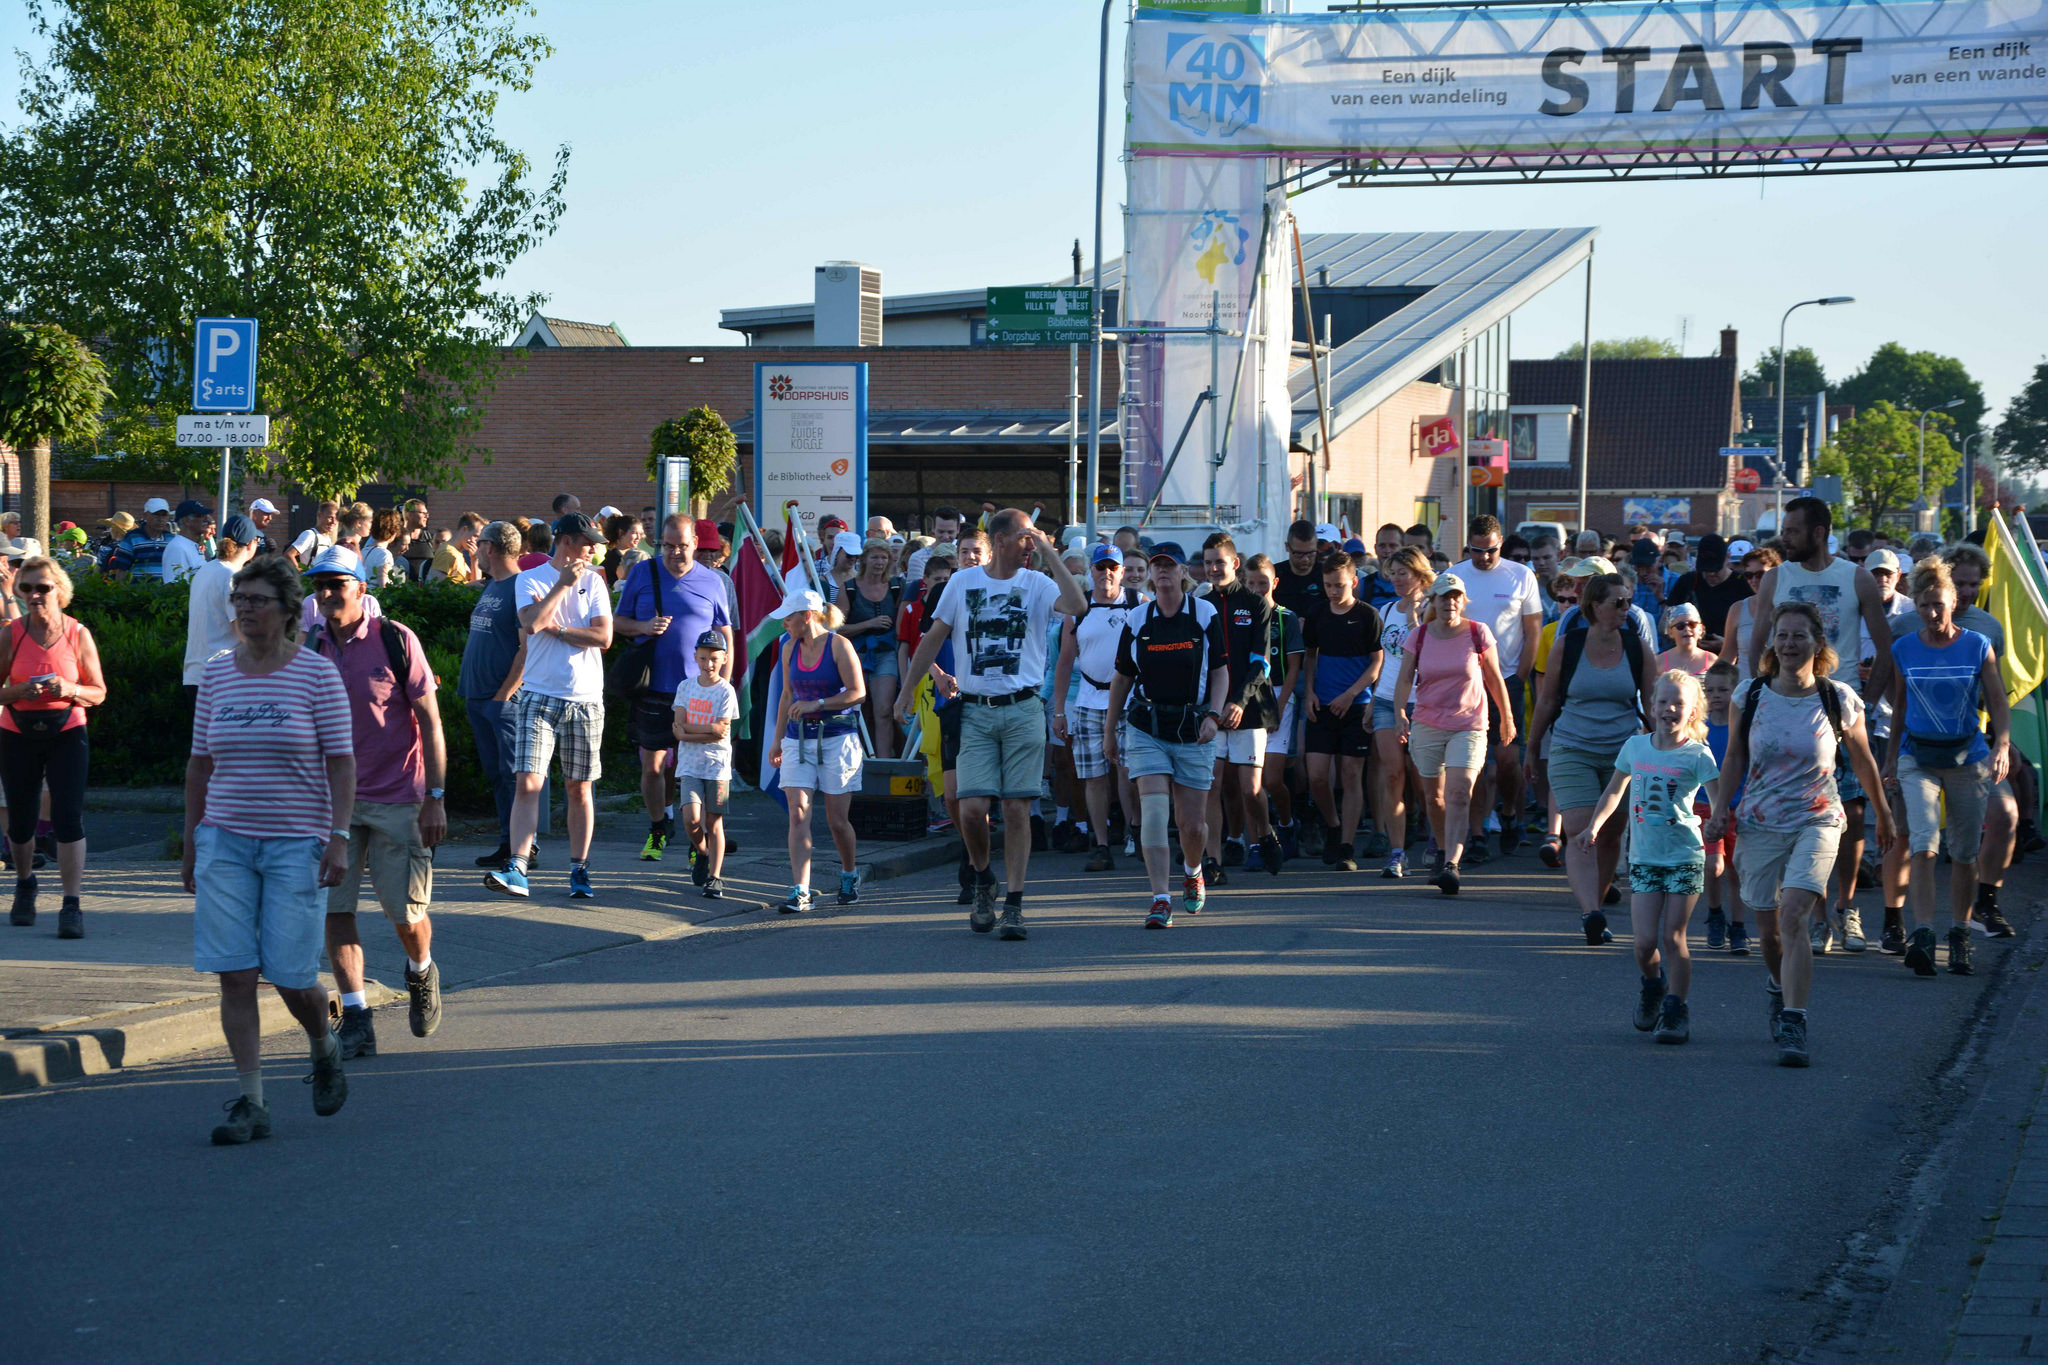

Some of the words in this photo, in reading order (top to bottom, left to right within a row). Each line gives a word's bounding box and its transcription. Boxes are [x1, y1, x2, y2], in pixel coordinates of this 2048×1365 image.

[1948, 46, 1986, 60] Een
[1992, 41, 2031, 61] dijk
[1186, 41, 1246, 82] 40
[1382, 69, 1416, 84] Een
[1421, 67, 1457, 86] dijk
[1537, 37, 1863, 117] START
[1891, 72, 1928, 85] van
[1934, 69, 1971, 83] een
[1330, 93, 1364, 106] van
[1369, 92, 1403, 105] een
[1409, 88, 1508, 106] wandeling
[1025, 302, 1044, 311] VILLA
[1047, 316, 1089, 327] Bibliotheek
[1002, 331, 1041, 342] Dorpshuis
[1054, 331, 1089, 341] Centrum
[208, 327, 241, 373] P
[215, 384, 245, 396] arts
[784, 391, 849, 401] DORPSHUIS
[194, 420, 210, 429] ma
[215, 418, 234, 430] t/m
[239, 420, 251, 429] vr
[178, 433, 213, 443] 07.00
[226, 433, 264, 443] 18.00h
[791, 427, 824, 439] ZUIDER
[1424, 426, 1450, 448] da
[791, 439, 824, 450] KOGGE
[767, 471, 779, 481] de
[780, 471, 832, 481] Bibliotheek
[689, 697, 713, 714] COOL
